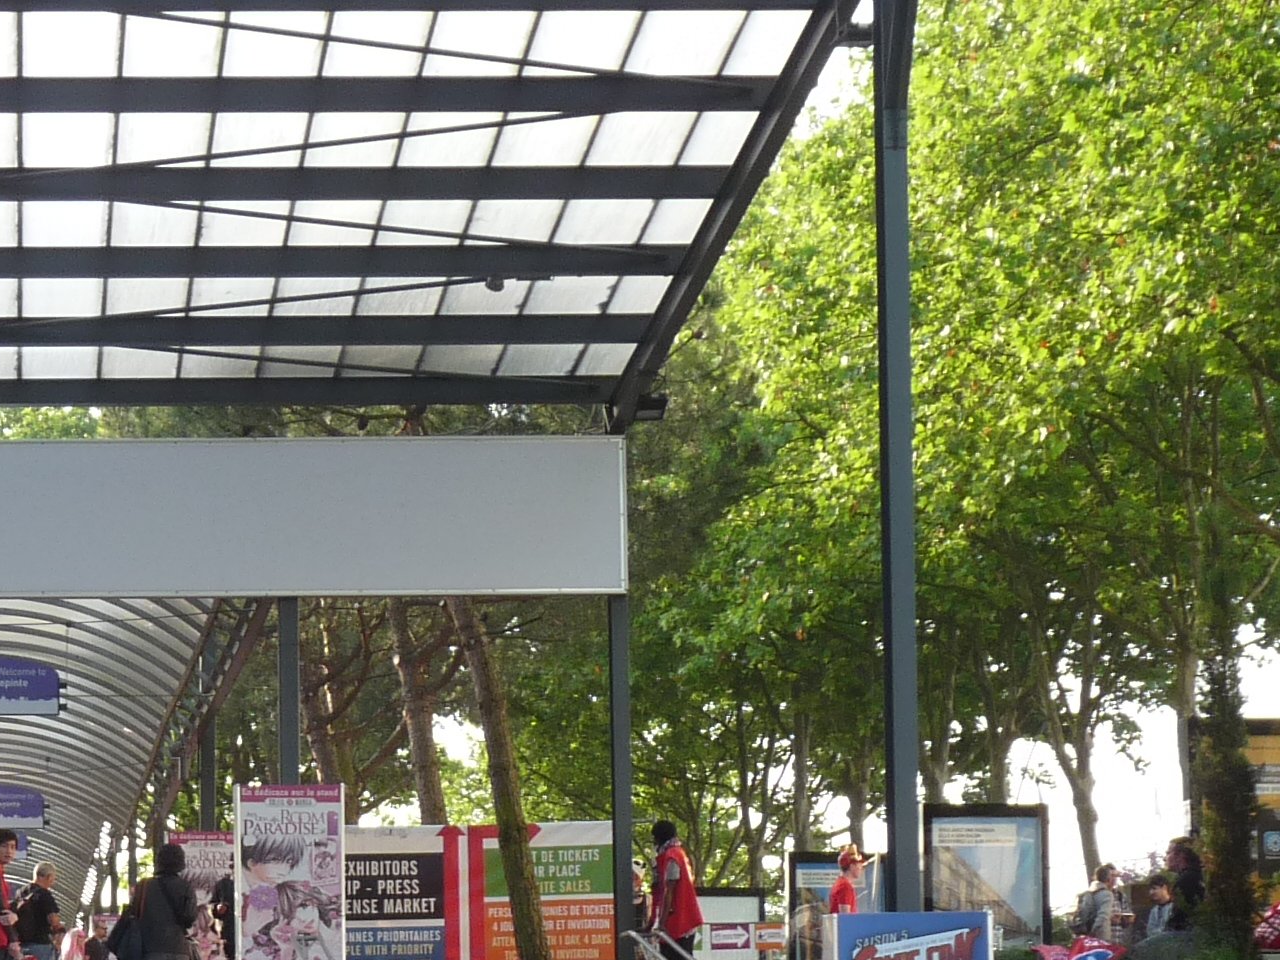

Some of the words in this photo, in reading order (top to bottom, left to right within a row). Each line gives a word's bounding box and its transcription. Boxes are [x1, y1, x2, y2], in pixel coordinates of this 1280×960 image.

[37, 668, 47, 677] to
[244, 819, 320, 836] PARADISE
[541, 851, 555, 863] DE
[558, 849, 600, 862] TICKETS
[185, 859, 228, 869] RADISE
[549, 864, 582, 877] PLACE
[344, 880, 361, 896] IP
[377, 879, 420, 895] PRESS
[559, 879, 592, 893] SALES
[345, 899, 379, 914] ENSE
[383, 898, 437, 914] MARKET
[570, 905, 581, 916] DE
[582, 904, 615, 916] TICKETS
[556, 920, 566, 931] ET
[567, 919, 610, 930] INVITATION
[376, 930, 441, 943] PRIORITAIRES
[591, 934, 613, 945] DAYS
[854, 933, 897, 950] SAISON
[900, 929, 909, 941] 5
[364, 944, 388, 956] WITH
[391, 943, 434, 955] PRIORITY
[557, 949, 600, 960] INVITATION
